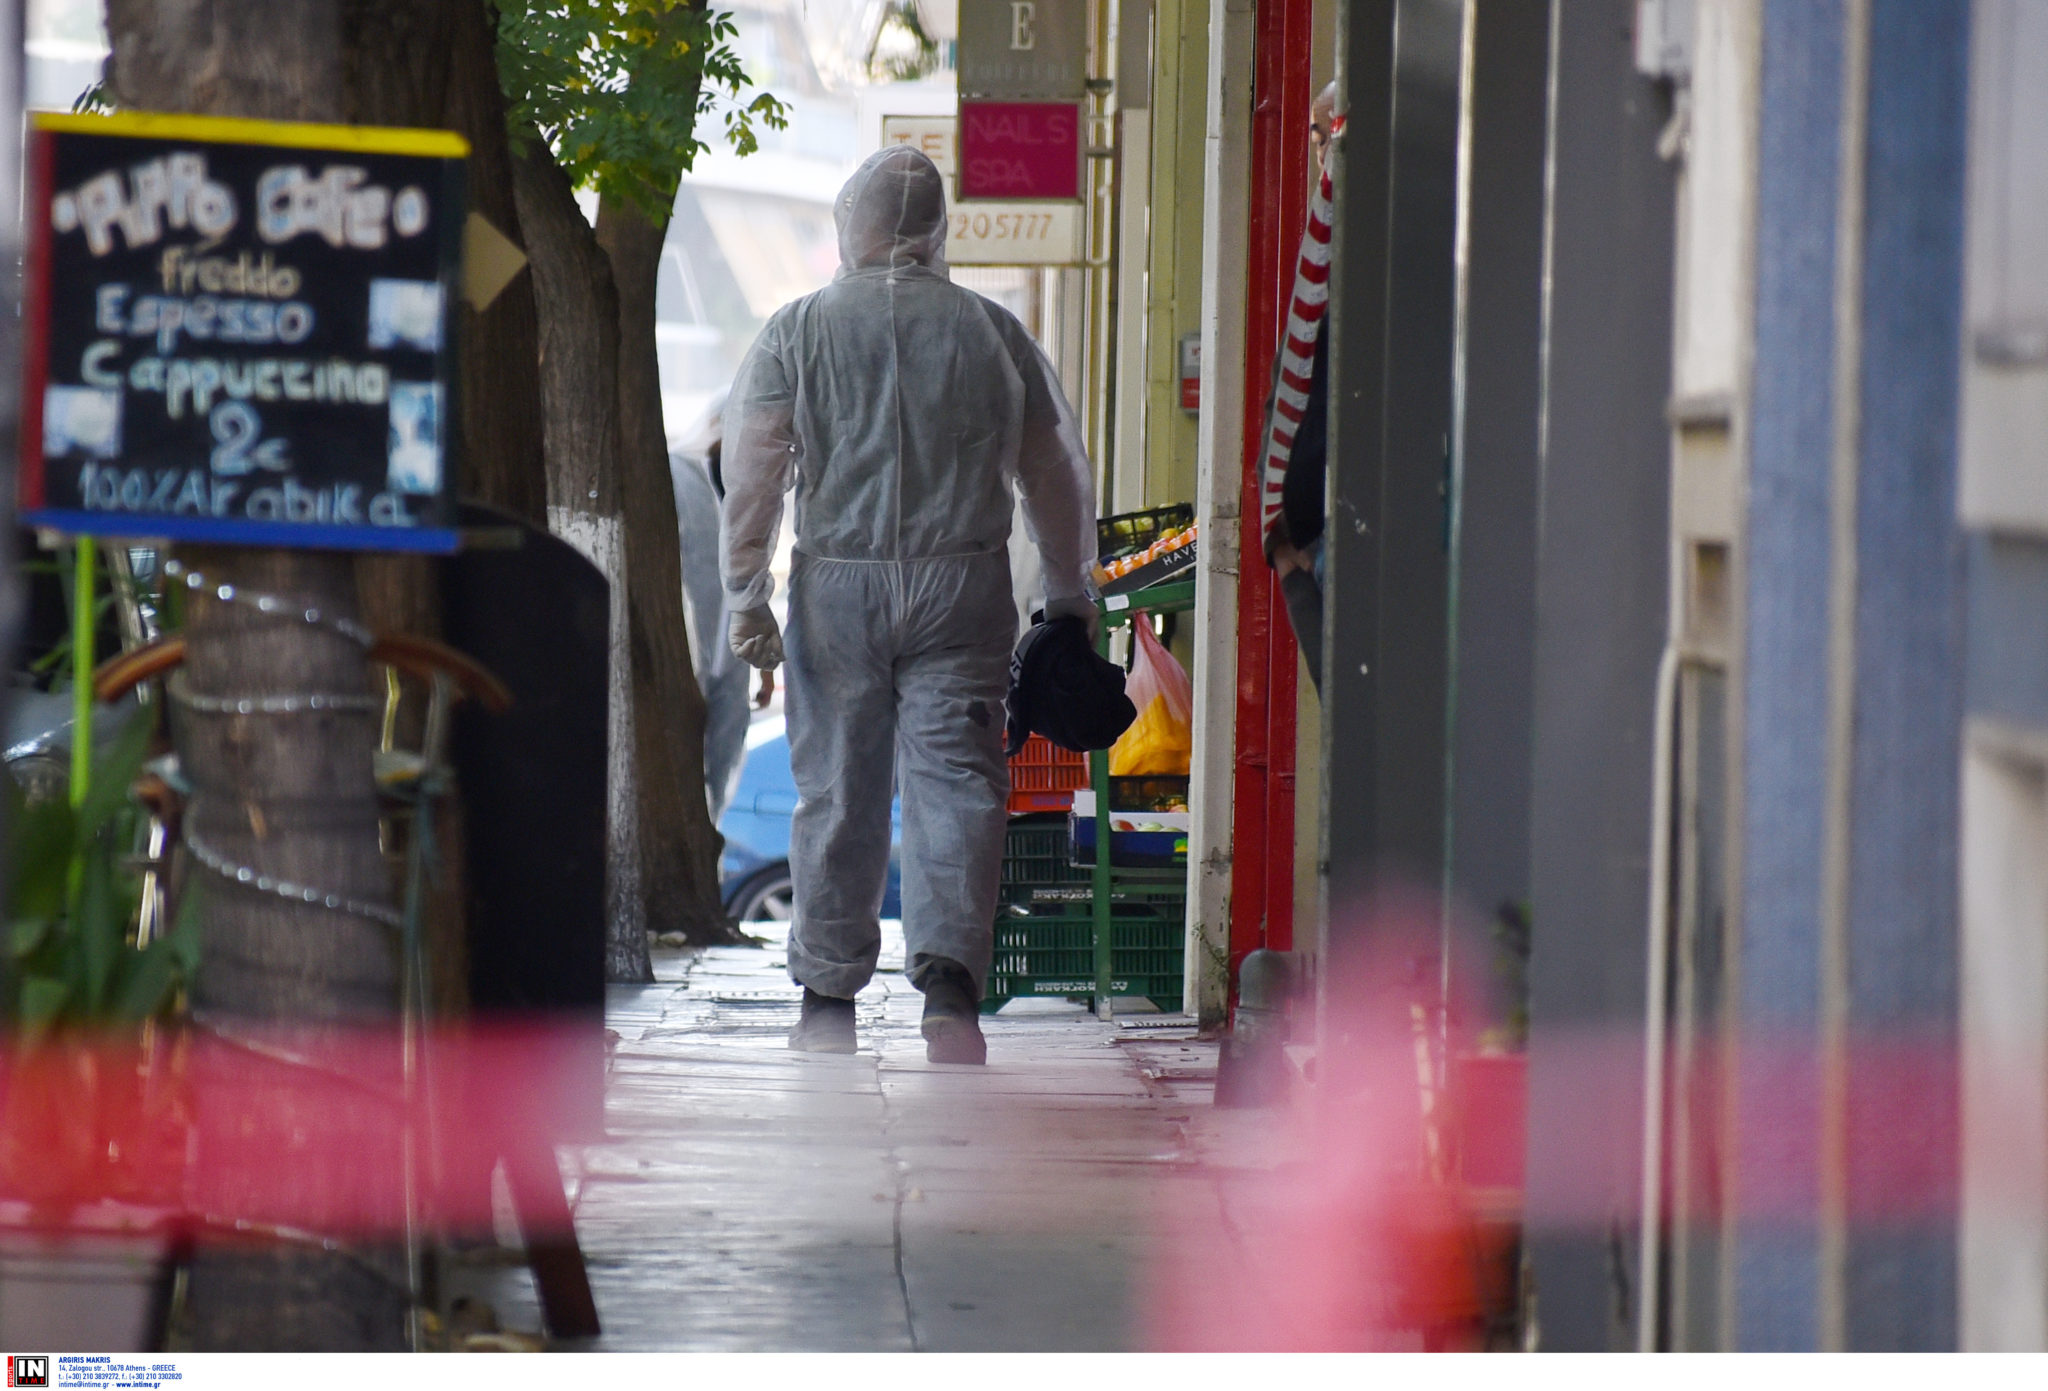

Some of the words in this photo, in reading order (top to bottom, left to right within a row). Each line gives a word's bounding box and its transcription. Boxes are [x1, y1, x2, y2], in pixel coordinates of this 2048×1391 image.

[1010, 1, 1036, 51] E
[967, 113, 1070, 146] NAILS
[967, 158, 1034, 190] SPA
[947, 213, 1054, 241] 205777
